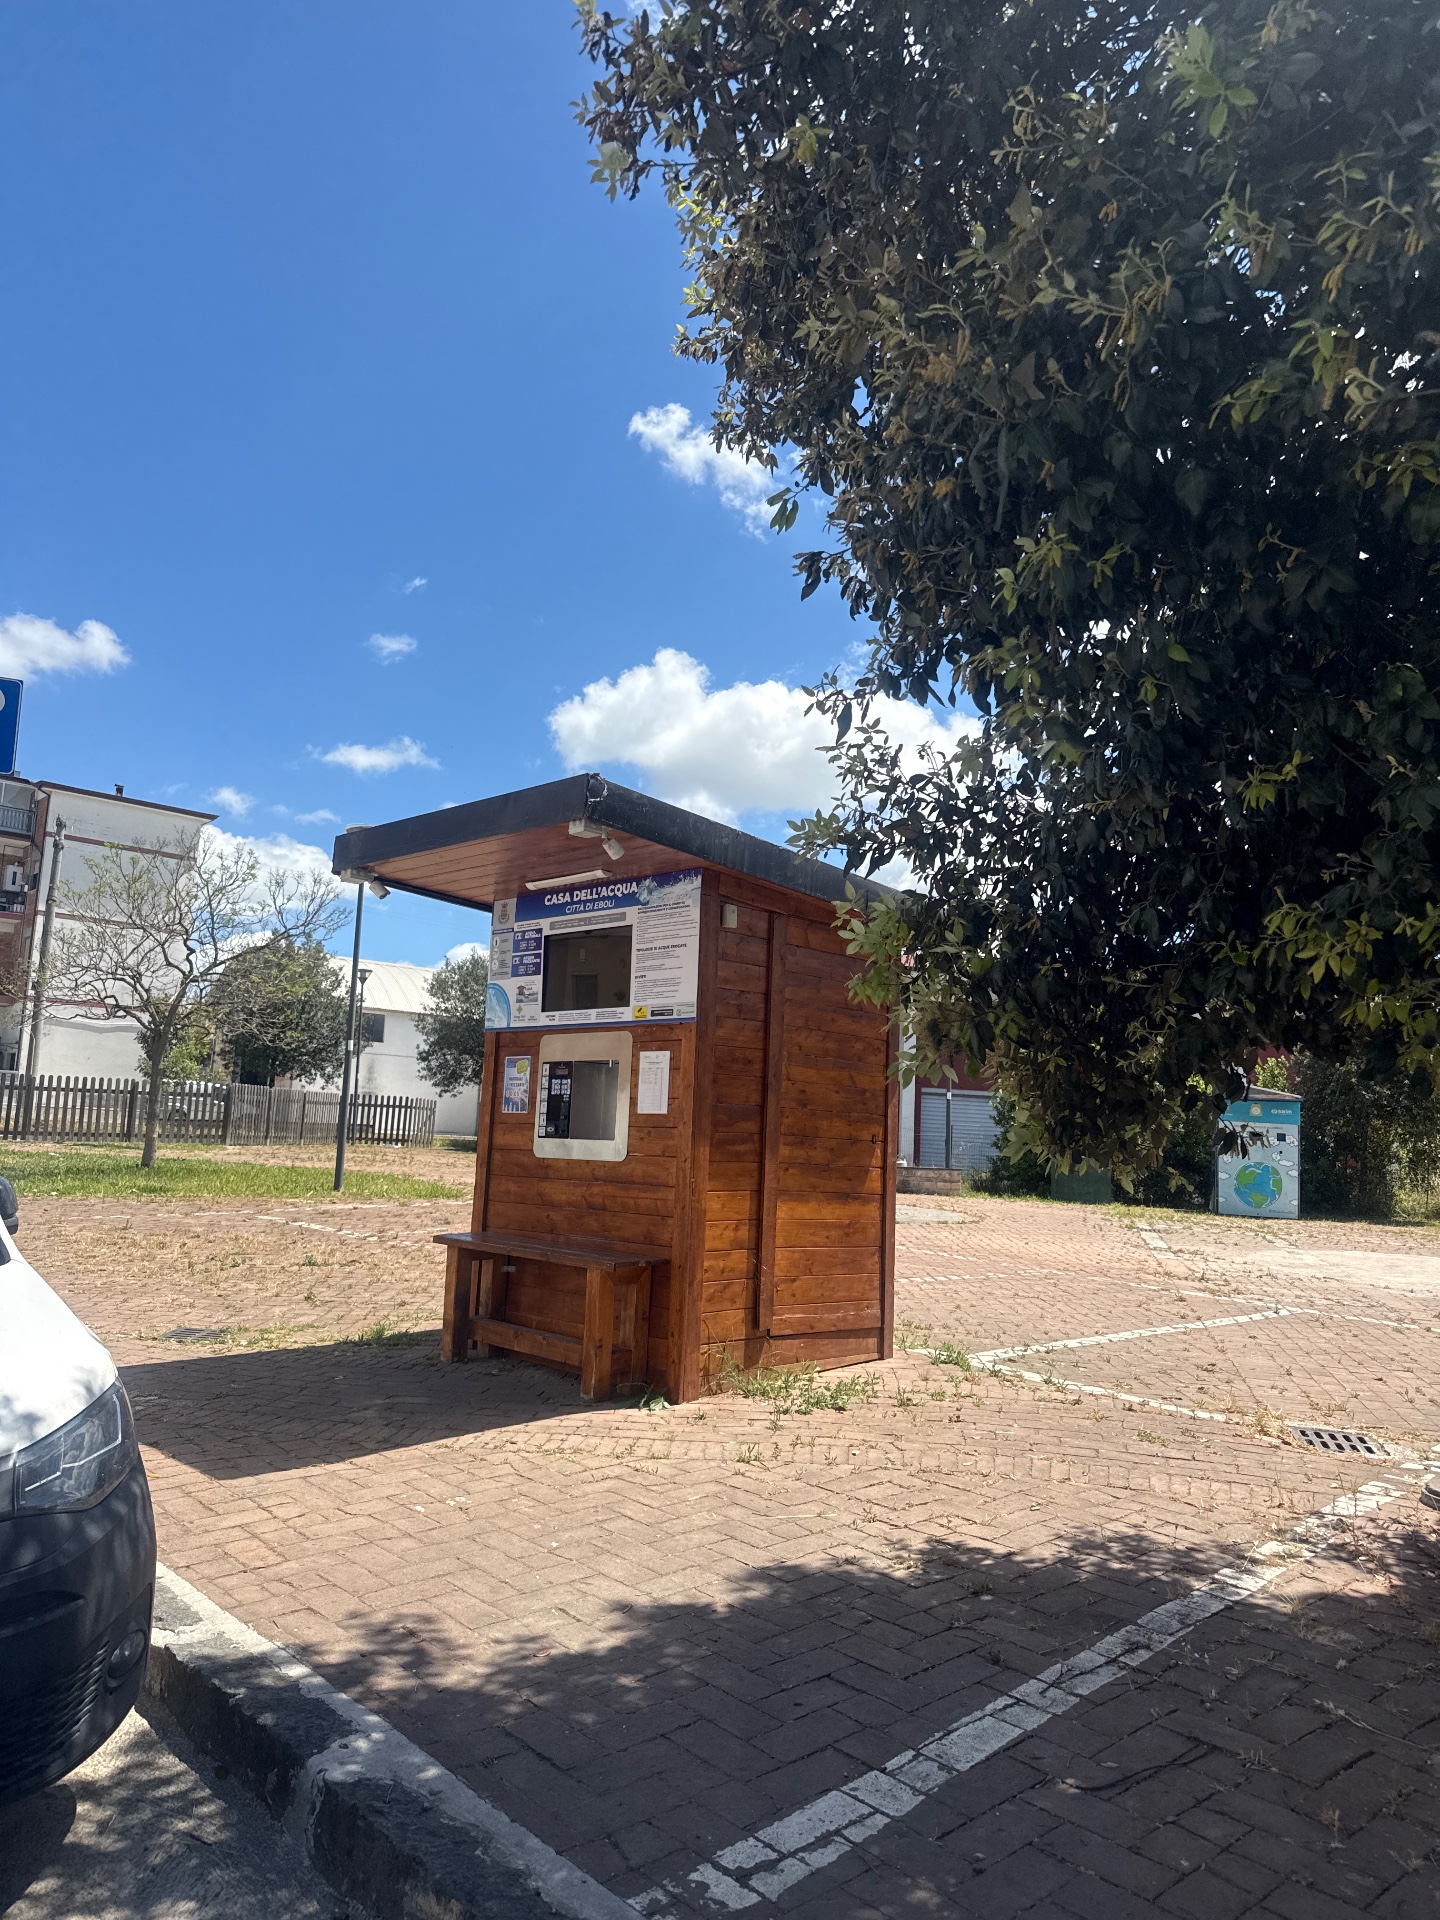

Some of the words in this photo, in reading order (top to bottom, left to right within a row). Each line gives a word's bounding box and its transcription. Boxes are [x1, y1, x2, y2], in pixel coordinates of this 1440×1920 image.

[544, 892, 571, 906] CASA
[573, 882, 638, 902] DELL'ACQUA
[565, 902, 585, 914] CITTÀ
[585, 902, 593, 911] DI
[594, 899, 615, 910] EBOLI
